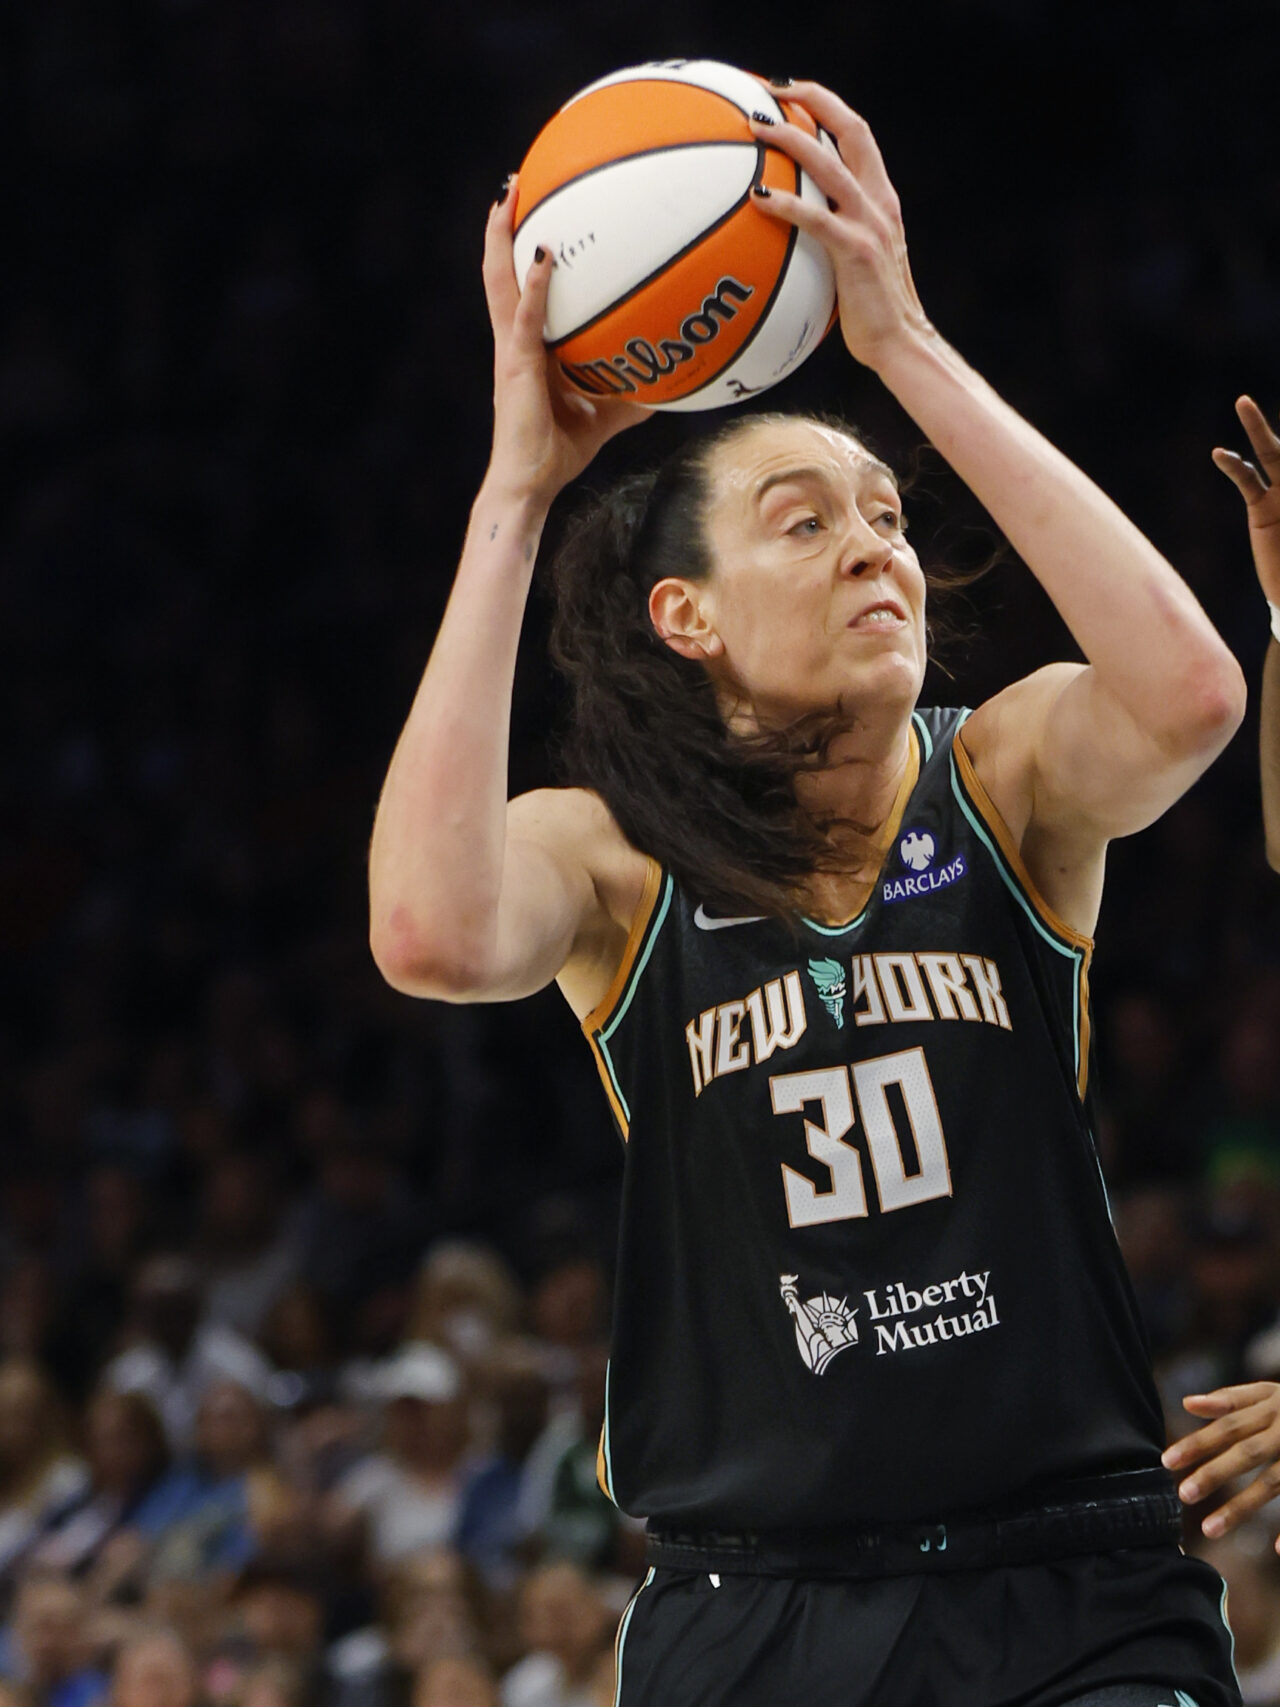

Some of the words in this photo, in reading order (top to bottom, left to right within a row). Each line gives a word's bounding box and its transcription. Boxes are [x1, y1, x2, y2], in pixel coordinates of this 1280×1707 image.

[561, 275, 754, 394] Wilson
[883, 858, 964, 901] BARCLAYS
[685, 970, 807, 1098] NEW
[852, 951, 1012, 1031] YORK
[769, 1046, 952, 1228] 30
[863, 1271, 990, 1320] Liberty
[874, 1295, 1000, 1355] Mutual
